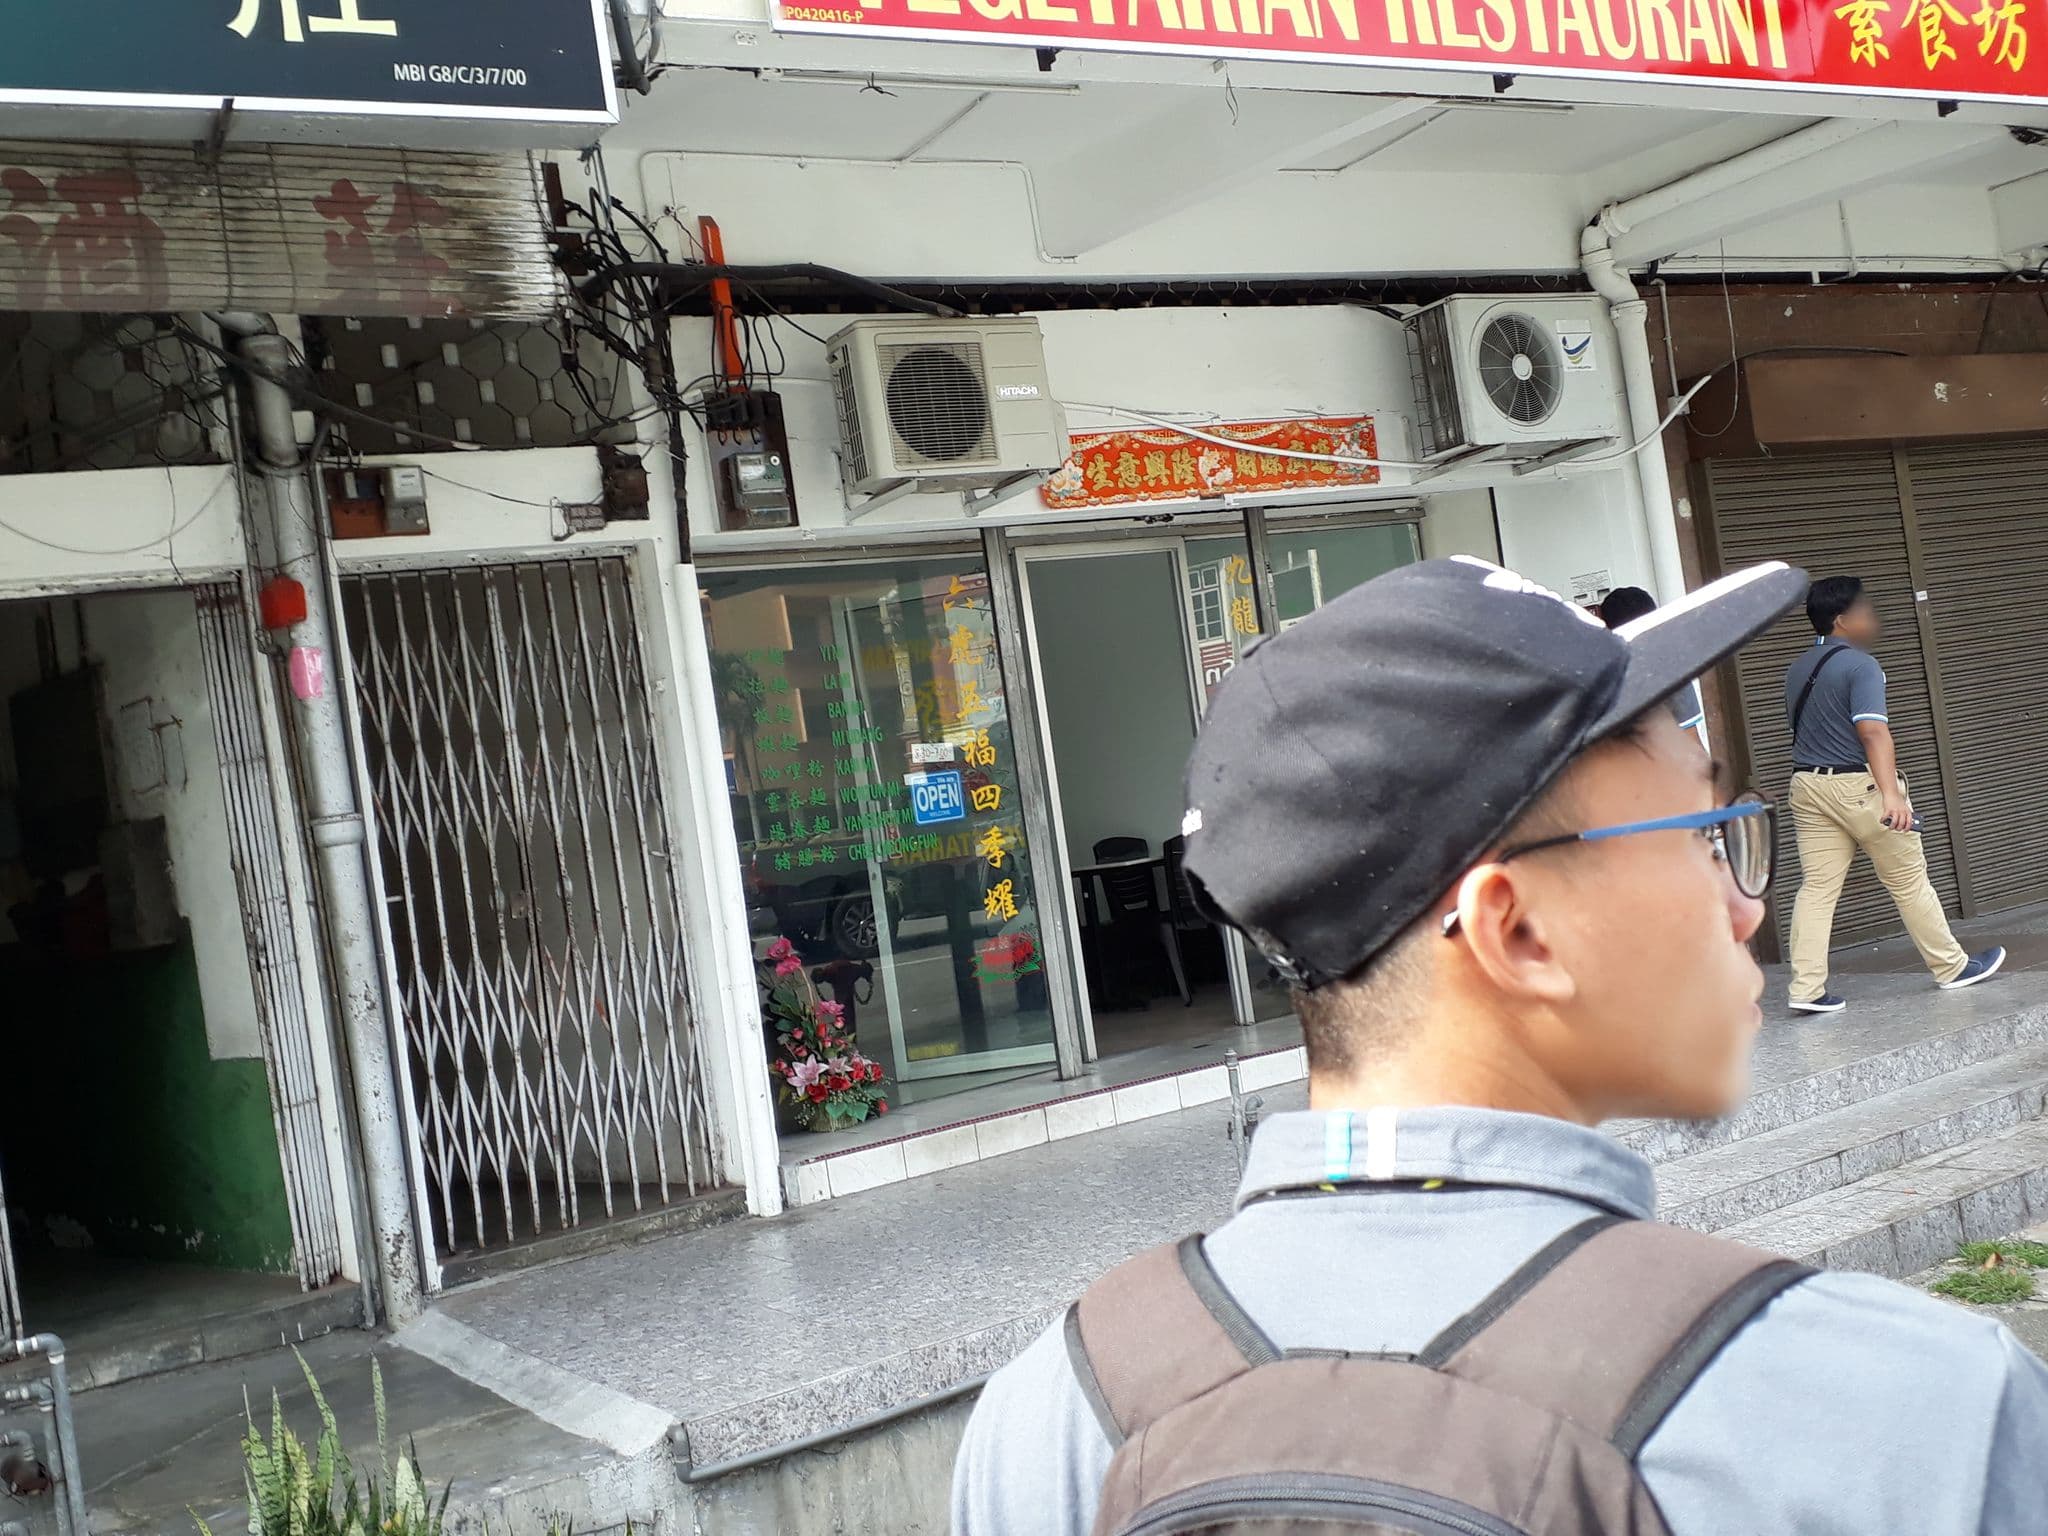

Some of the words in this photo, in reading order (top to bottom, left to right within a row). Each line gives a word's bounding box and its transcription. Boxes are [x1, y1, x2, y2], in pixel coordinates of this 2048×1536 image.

[1833, 0, 2027, 72] 素食坊
[393, 63, 427, 82] MBI
[429, 65, 527, 86] G8/C/3/7/00
[999, 385, 1039, 397] HITACHI
[1086, 446, 1198, 492] 生意興隆
[916, 782, 960, 813] OPEN
